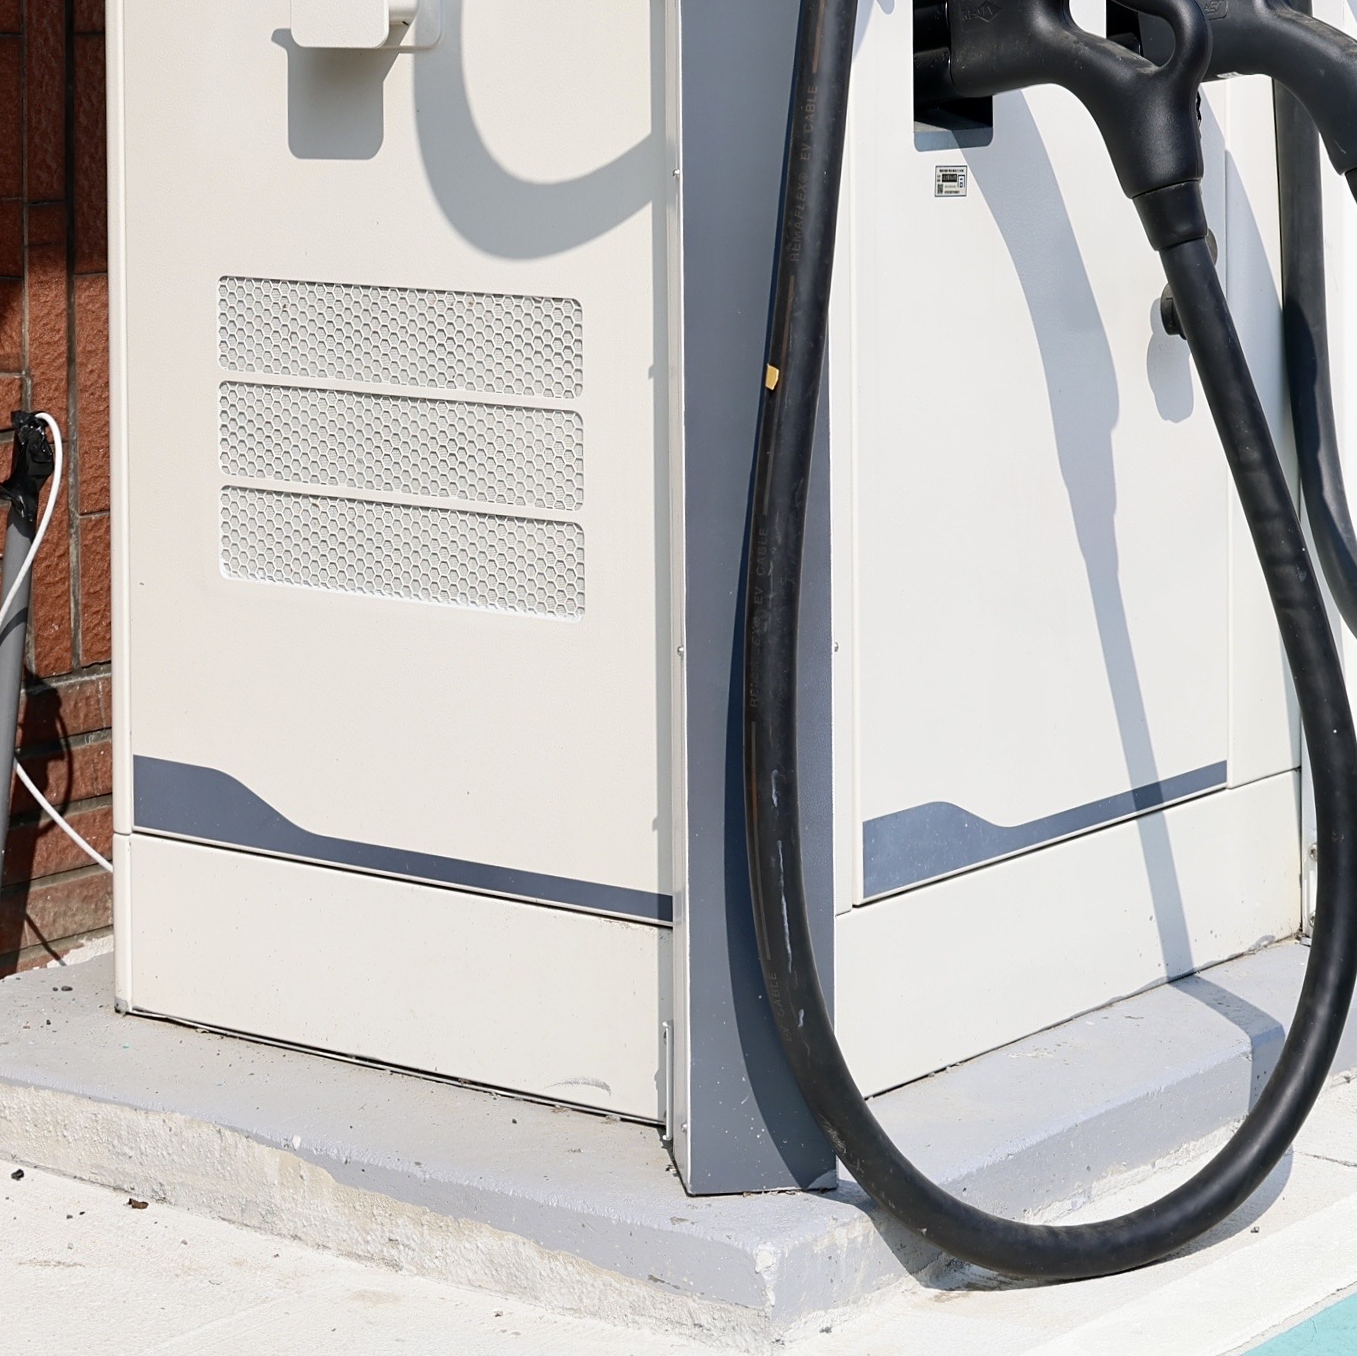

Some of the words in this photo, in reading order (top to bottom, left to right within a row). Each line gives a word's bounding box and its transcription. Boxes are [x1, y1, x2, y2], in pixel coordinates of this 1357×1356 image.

[803, 85, 818, 134] CABLE
[800, 143, 812, 161] EV
[756, 527, 769, 576] CABLE
